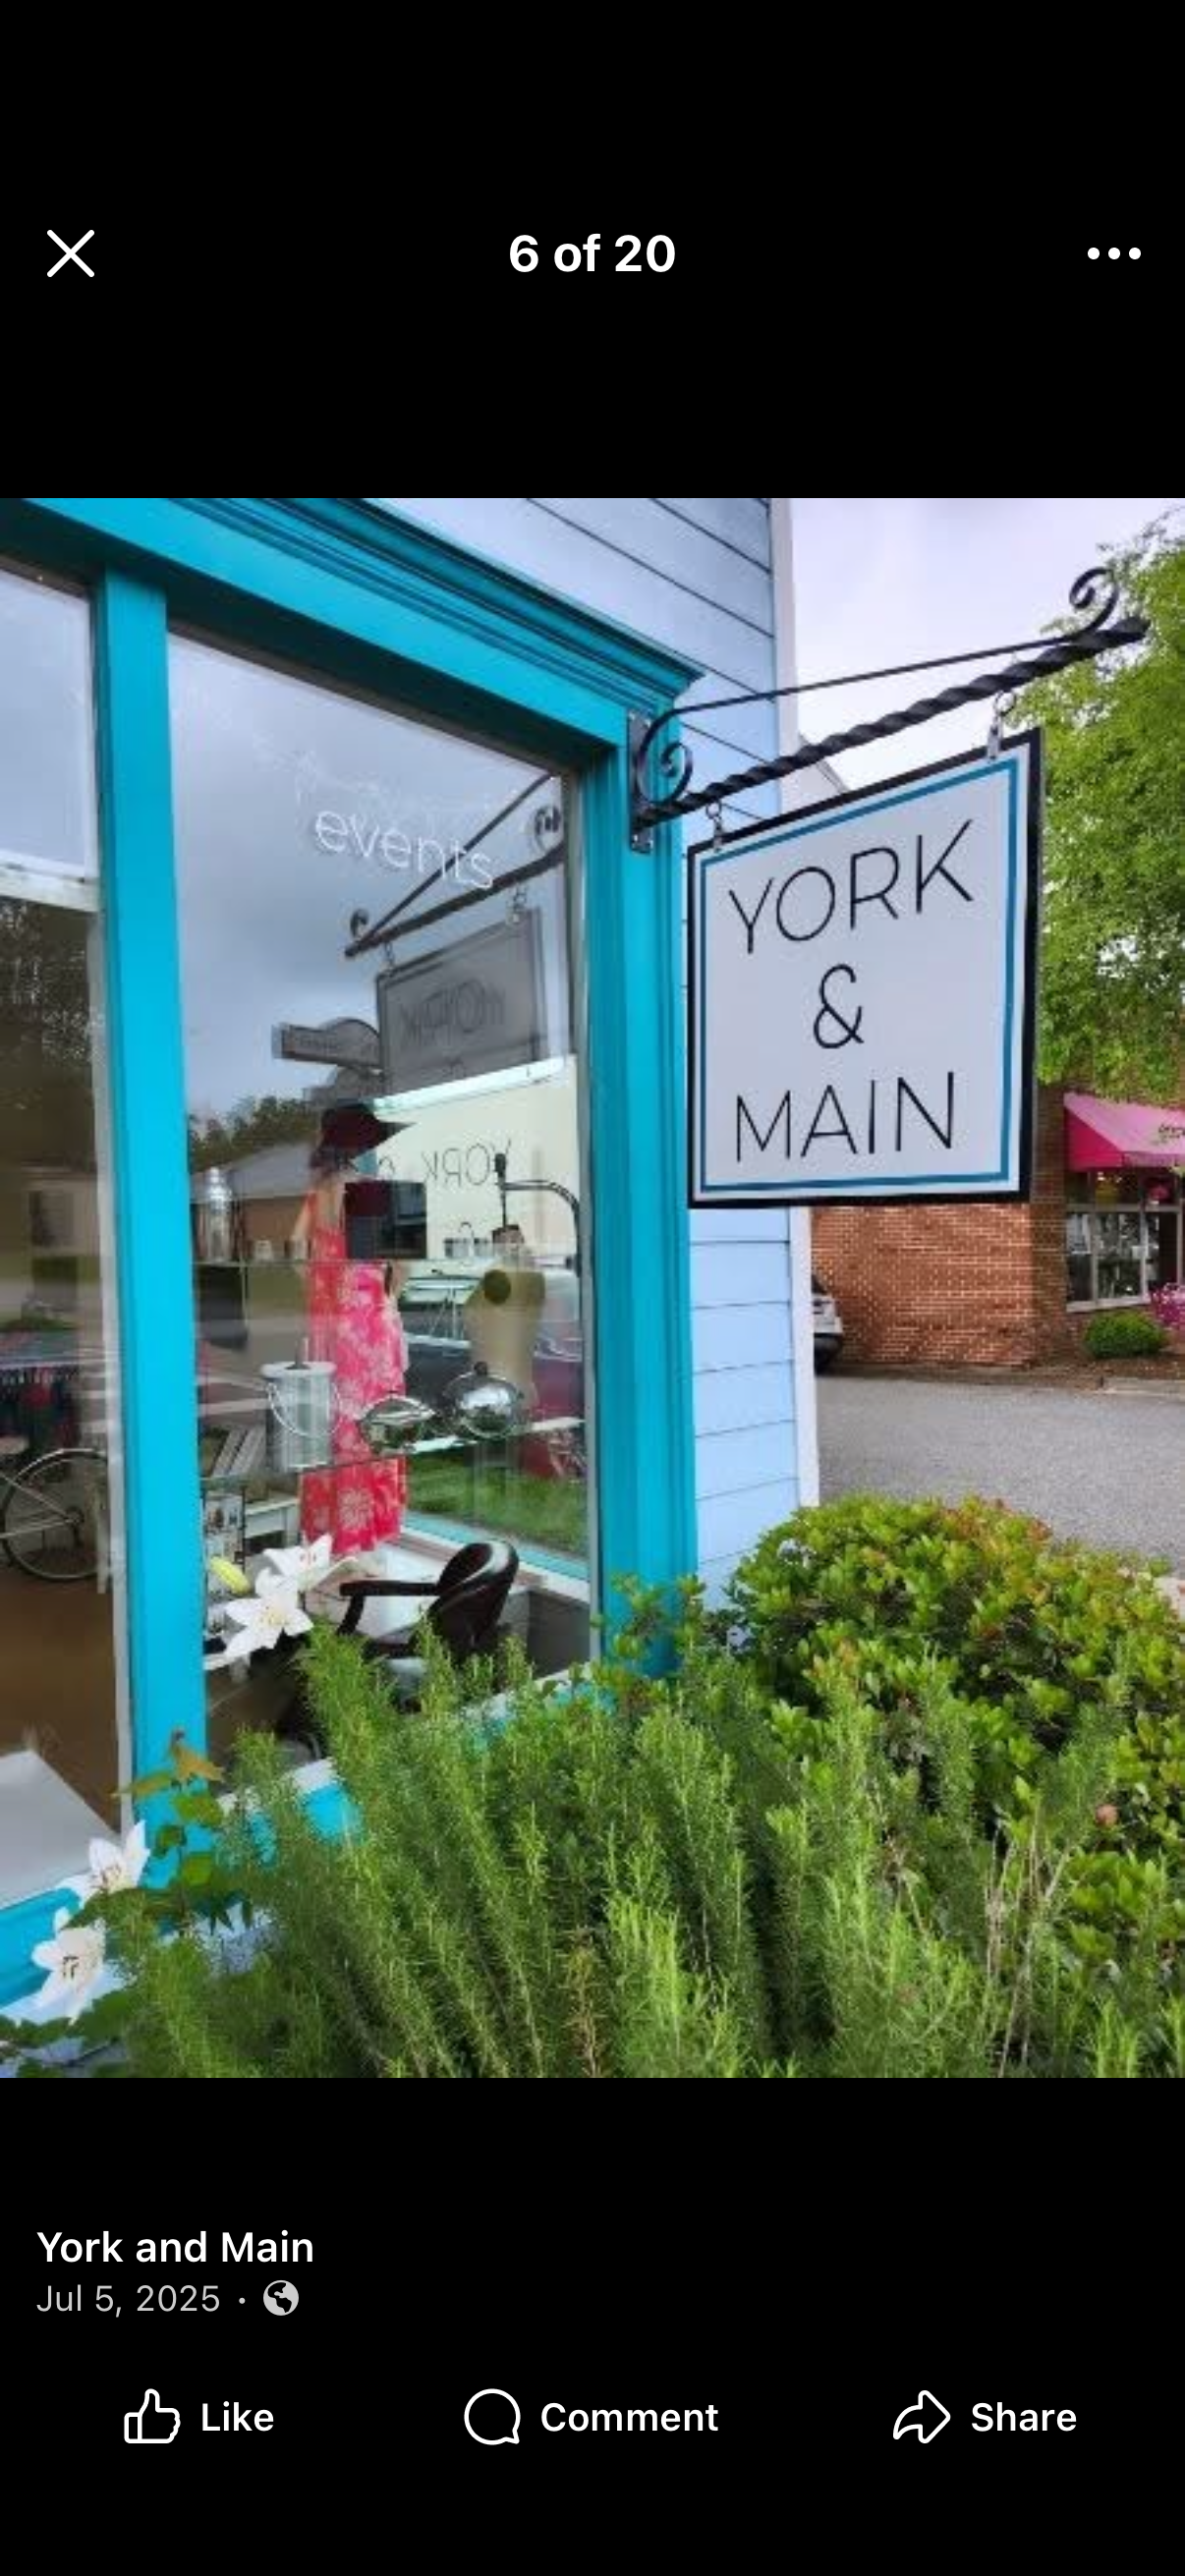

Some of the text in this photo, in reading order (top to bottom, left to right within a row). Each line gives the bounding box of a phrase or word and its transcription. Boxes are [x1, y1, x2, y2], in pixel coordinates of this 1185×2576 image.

[314, 811, 494, 889] events
[728, 817, 975, 955] YORK
[812, 963, 865, 1050] &
[736, 1070, 955, 1163] MAIN
